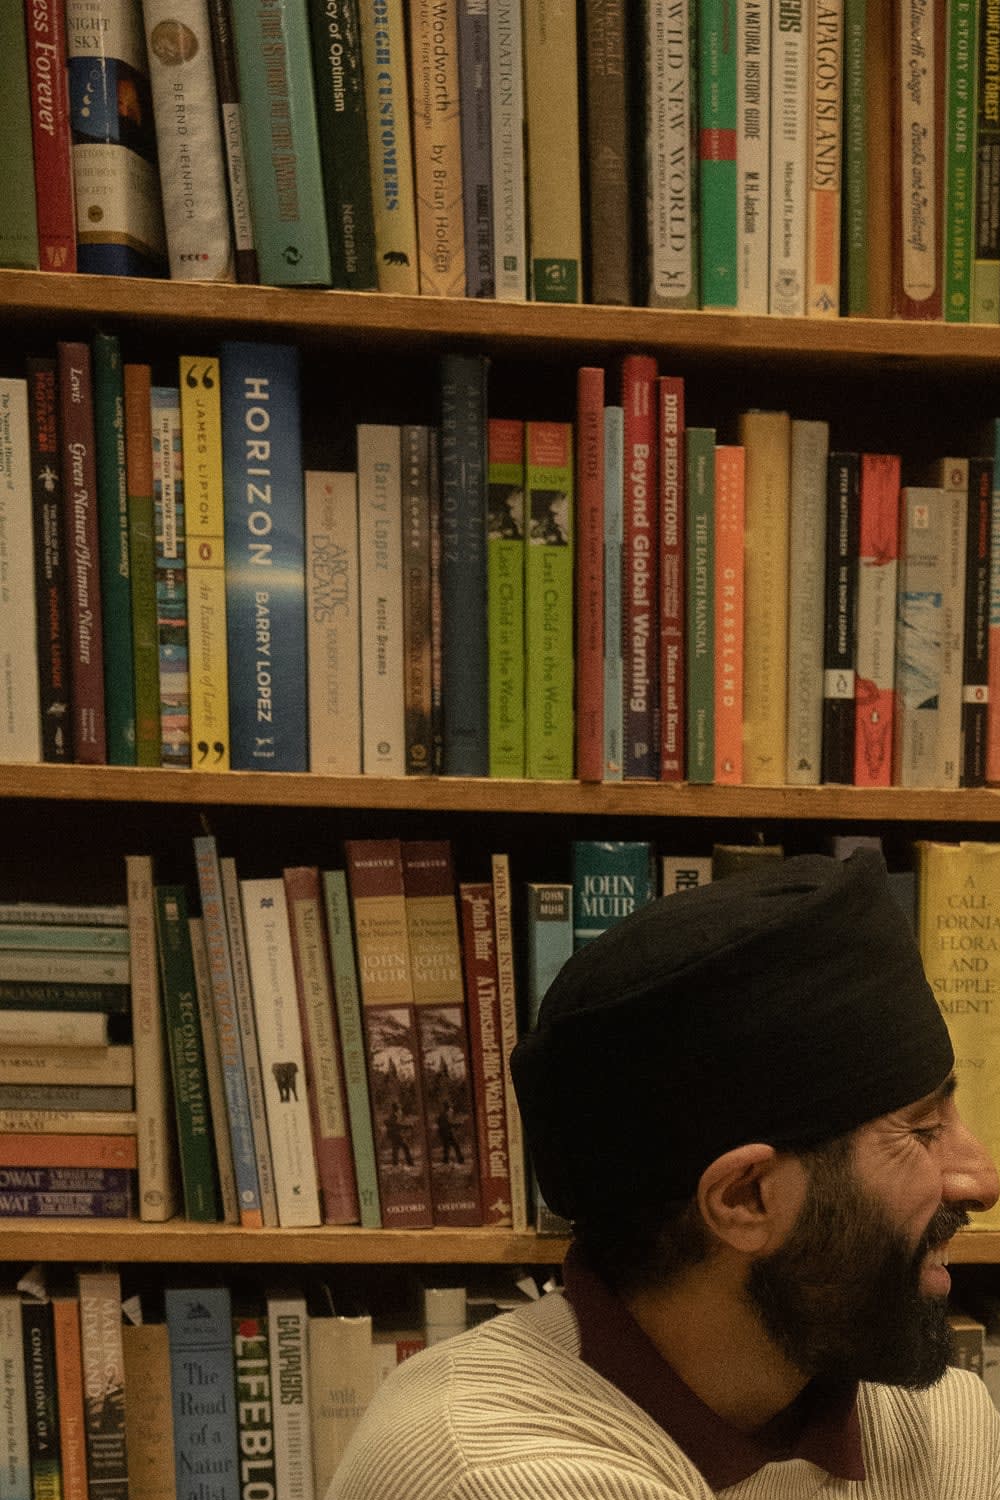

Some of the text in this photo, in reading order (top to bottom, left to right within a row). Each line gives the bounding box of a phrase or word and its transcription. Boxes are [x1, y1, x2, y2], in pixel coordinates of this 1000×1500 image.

[74, 36, 101, 50] SKY
[429, 3, 452, 274] Woodworth by Brian Holden
[666, 2, 686, 253] WILD NEW WORLD
[172, 83, 195, 220] BERND HEINRICH
[340, 203, 358, 273] Nebraska
[664, 393, 678, 434] DIRE
[664, 437, 678, 546] PREDICTIONS
[69, 368, 94, 663] Lewis Green Nature/Human Nature
[244, 377, 273, 723] HORIZON BARRY LOPEZ
[312, 535, 330, 624] DREAMS
[373, 462, 391, 675] Barry Lopez Arctic Dreams
[628, 443, 651, 712] Beyond Global Warming
[542, 552, 559, 736] Last Child in the Woods
[722, 567, 735, 708] GRASSLAND
[666, 645, 679, 681] Mann
[667, 684, 679, 703] and
[665, 706, 679, 753] Kump
[540, 890, 563, 901] JOHN
[585, 875, 636, 895] JOHN
[302, 908, 318, 938] Muir
[464, 893, 491, 929] John
[540, 903, 563, 914] MUIR
[583, 897, 636, 917] MUIR
[475, 931, 493, 961] Muir
[941, 936, 998, 951] FLORA
[477, 976, 495, 987] A
[951, 957, 989, 973] AND
[179, 991, 207, 1137] SECOND NATURE
[486, 1080, 503, 1112] Walk
[487, 1115, 501, 1127] to
[488, 1128, 503, 1149] the
[490, 1150, 507, 1178] Gulf
[81, 1297, 102, 1400] NEW LAND
[100, 1298, 119, 1395] MAKING A
[30, 1327, 48, 1418] CONFESSIONS
[183, 1362, 219, 1386] The
[180, 1393, 227, 1416] Road
[37, 1421, 48, 1438] OF
[38, 1441, 49, 1451] A
[191, 1427, 222, 1446] of a
